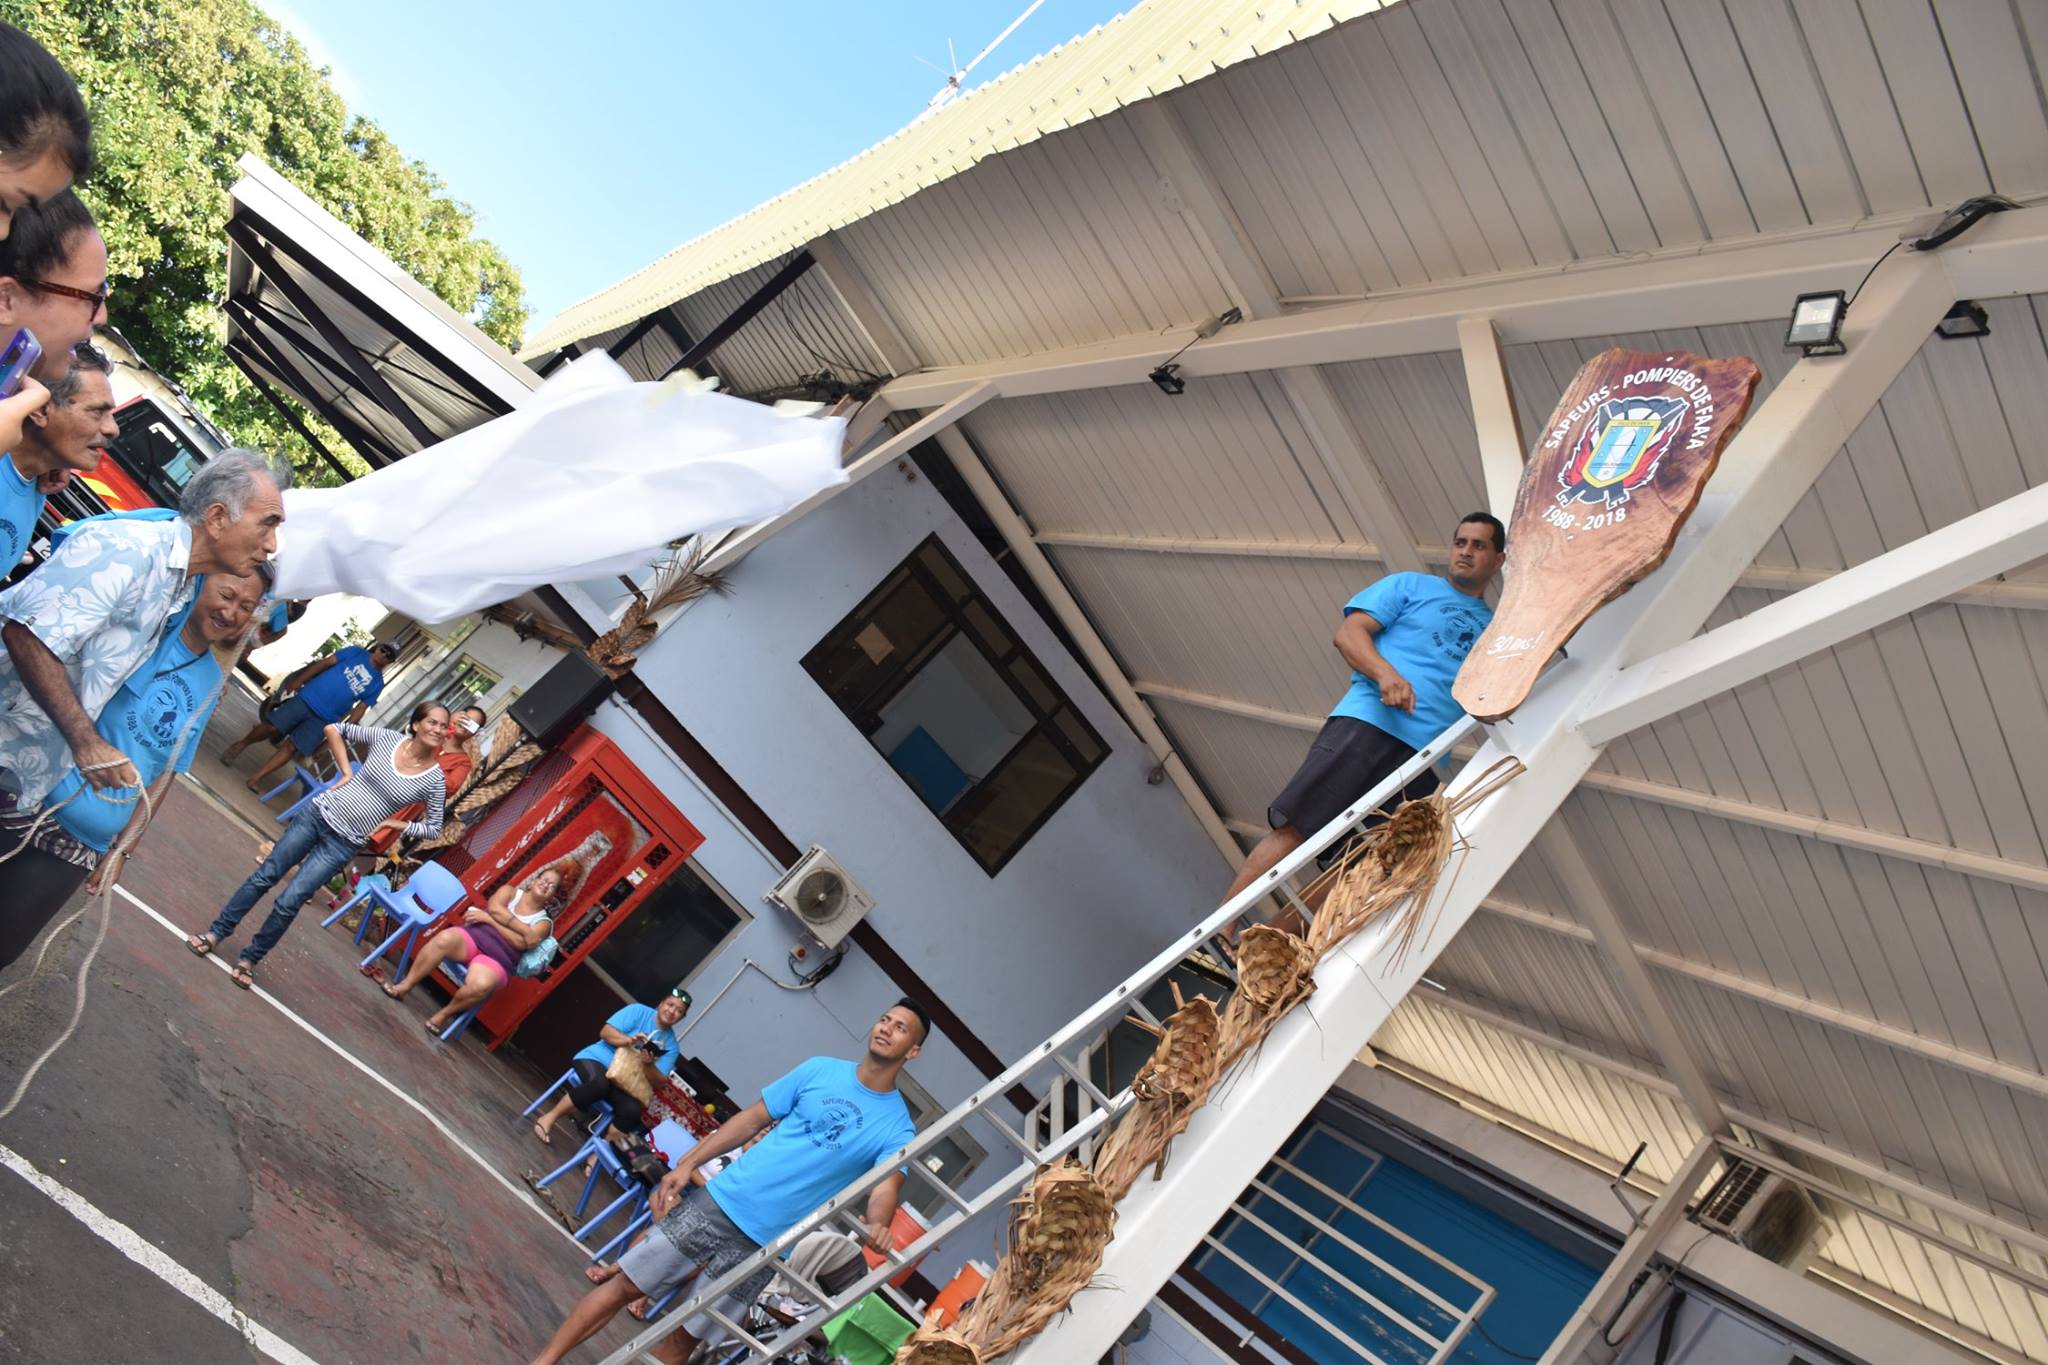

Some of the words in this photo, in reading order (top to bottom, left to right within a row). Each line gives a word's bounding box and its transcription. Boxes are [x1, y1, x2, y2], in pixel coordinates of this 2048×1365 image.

[1545, 385, 1610, 450] SAPEURS
[1622, 367, 1702, 393] POMPIERS
[1689, 385, 1713, 410] DE
[1541, 504, 1576, 530] 1988
[1582, 507, 1627, 531] 2018
